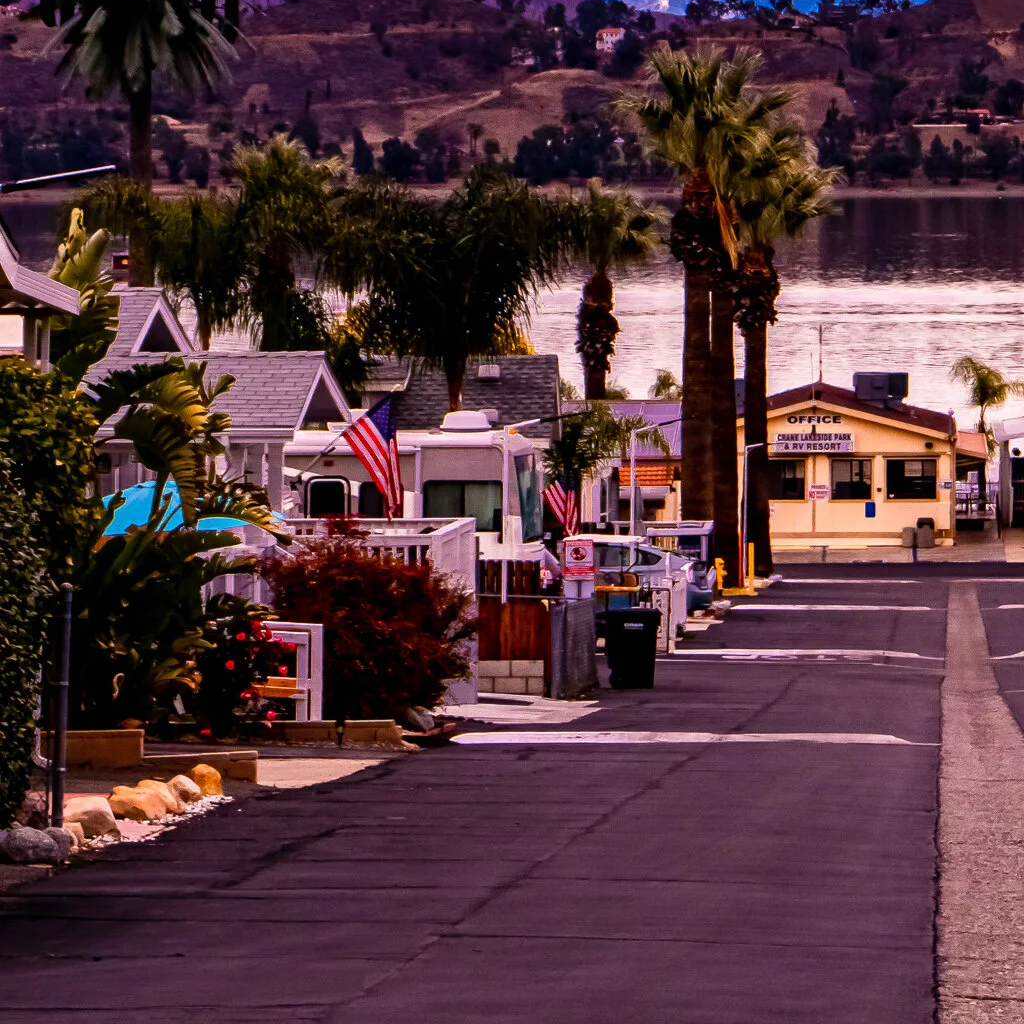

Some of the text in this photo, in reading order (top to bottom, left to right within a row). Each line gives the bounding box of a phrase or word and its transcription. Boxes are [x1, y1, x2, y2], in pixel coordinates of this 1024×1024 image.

[787, 416, 842, 424] OFFICE
[778, 433, 852, 442] CRANE LAKESIDE PARK
